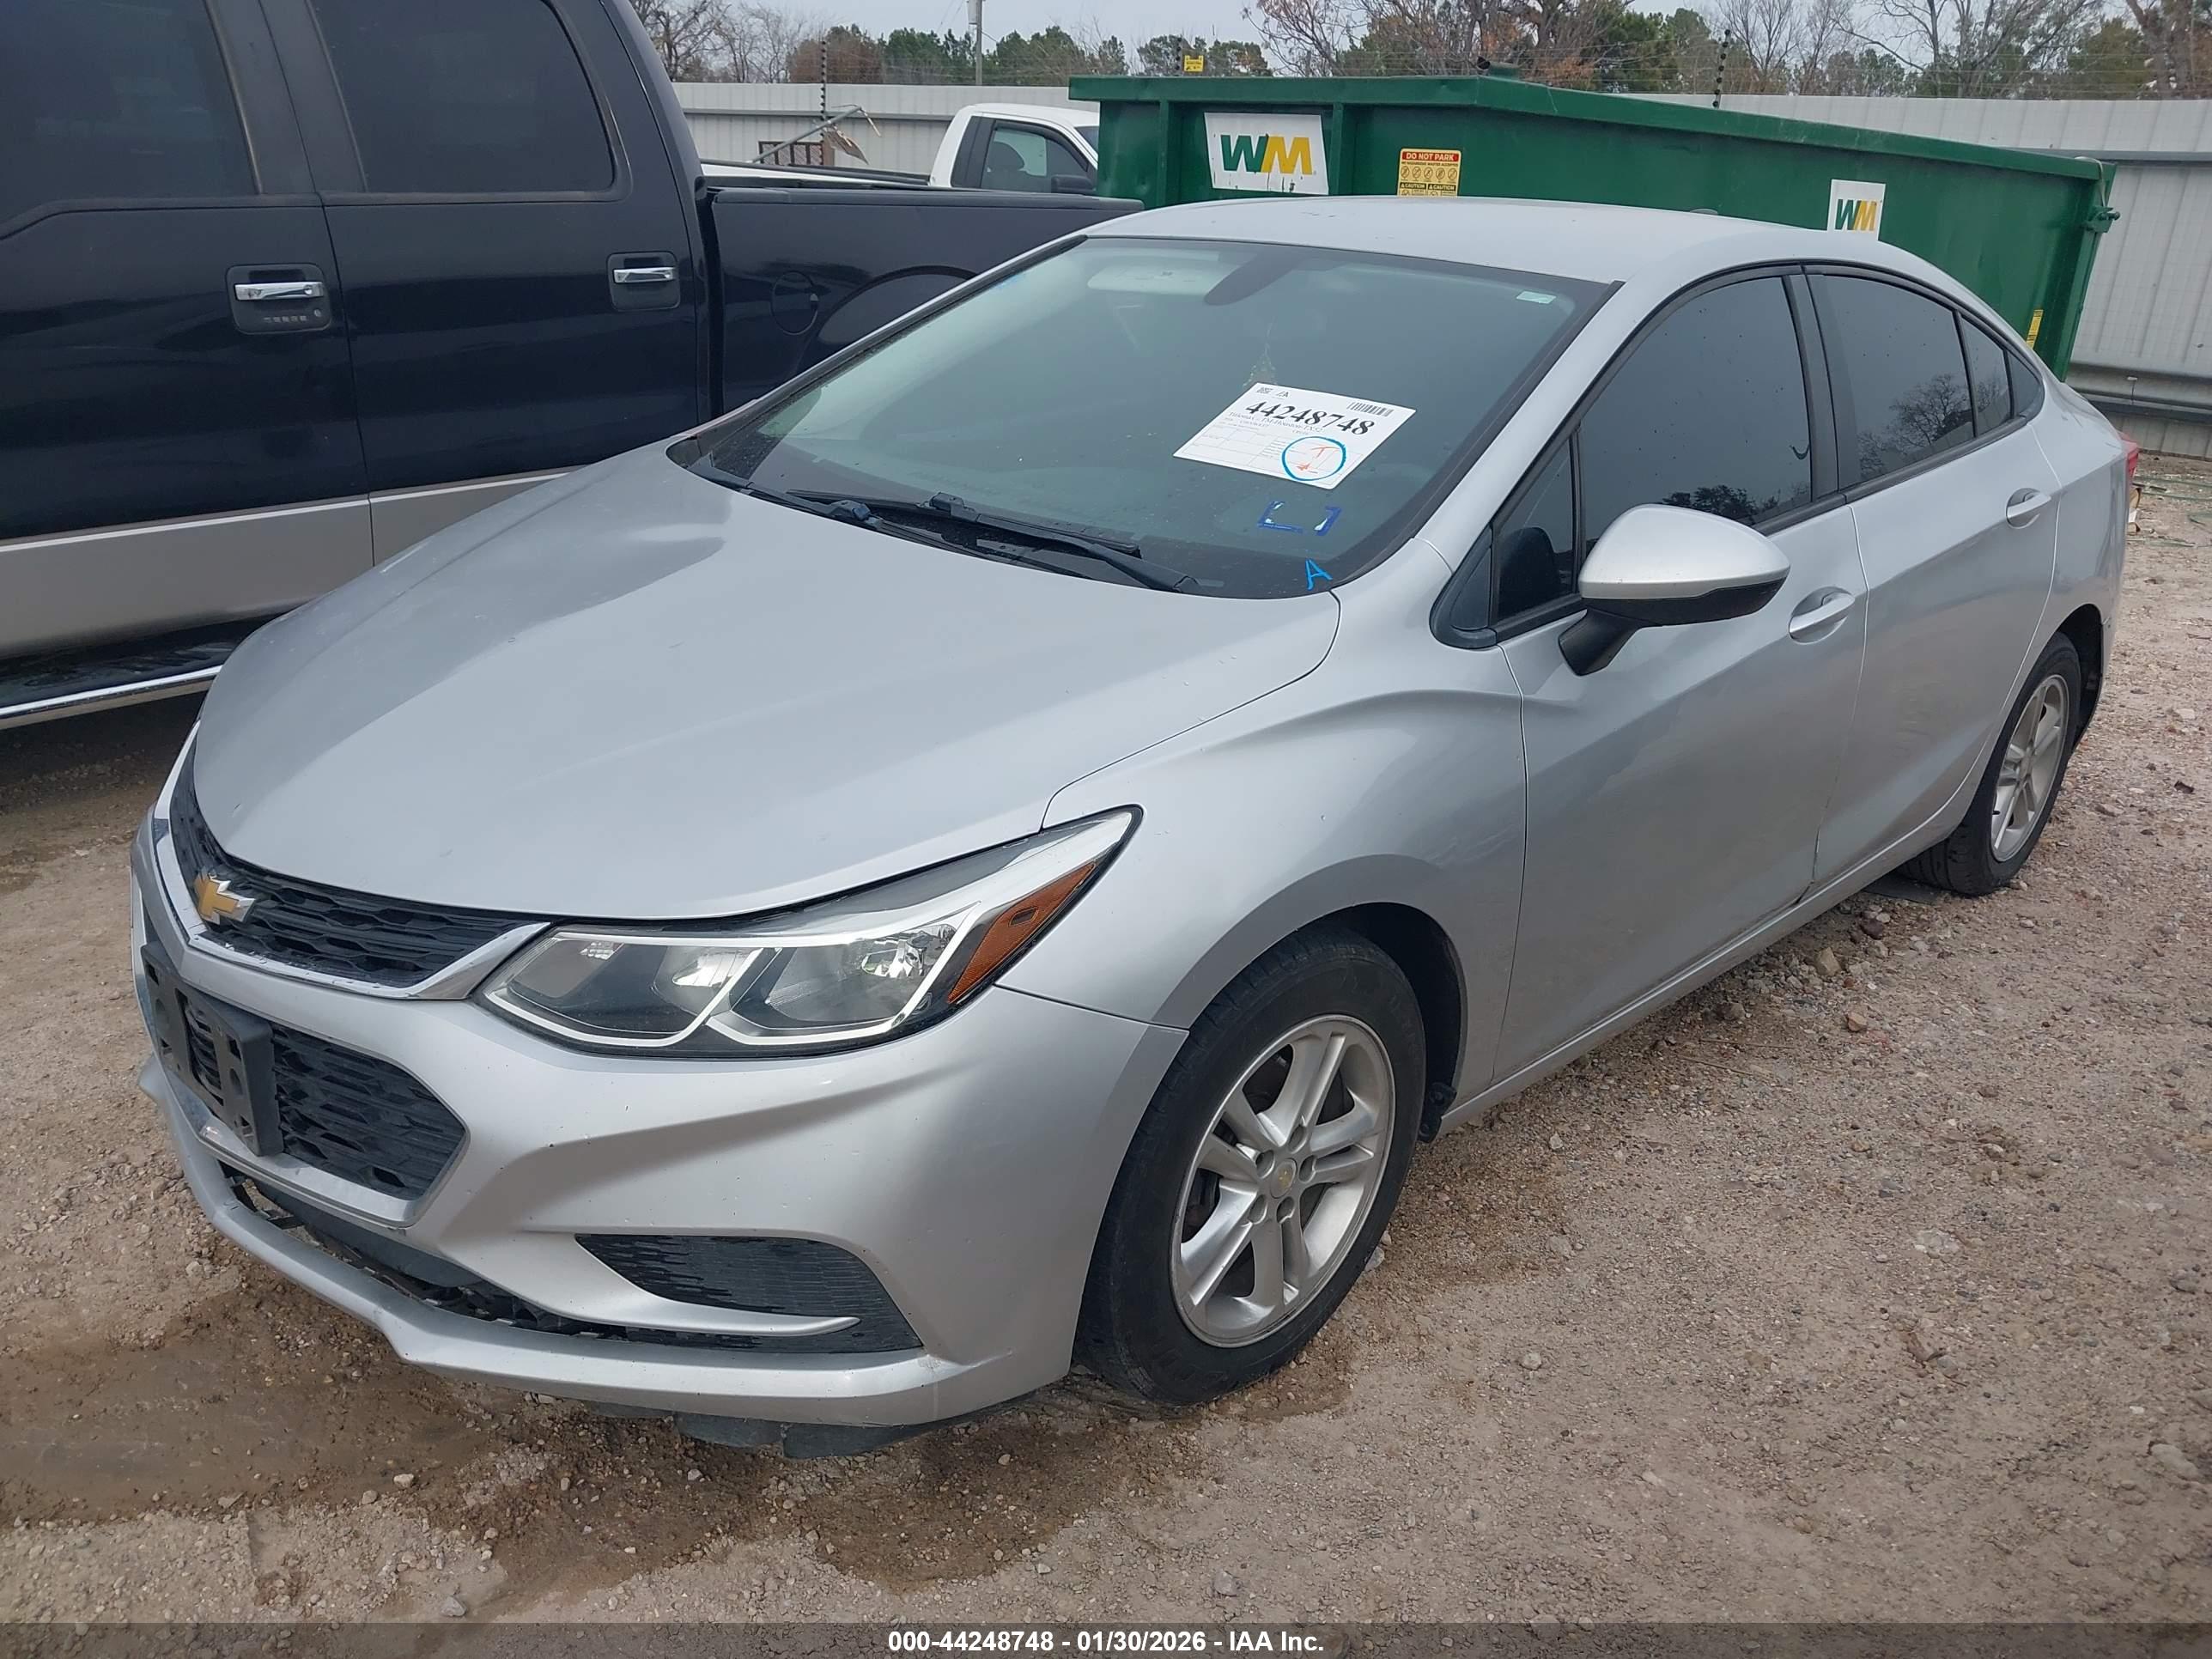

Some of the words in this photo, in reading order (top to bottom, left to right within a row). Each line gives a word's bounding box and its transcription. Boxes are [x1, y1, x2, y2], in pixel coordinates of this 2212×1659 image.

[1220, 134, 1313, 175] WM
[1434, 153, 1455, 161] PARK
[1835, 198, 1878, 231] WM
[1245, 400, 1376, 436] 44248748
[1304, 558, 1333, 591] A
